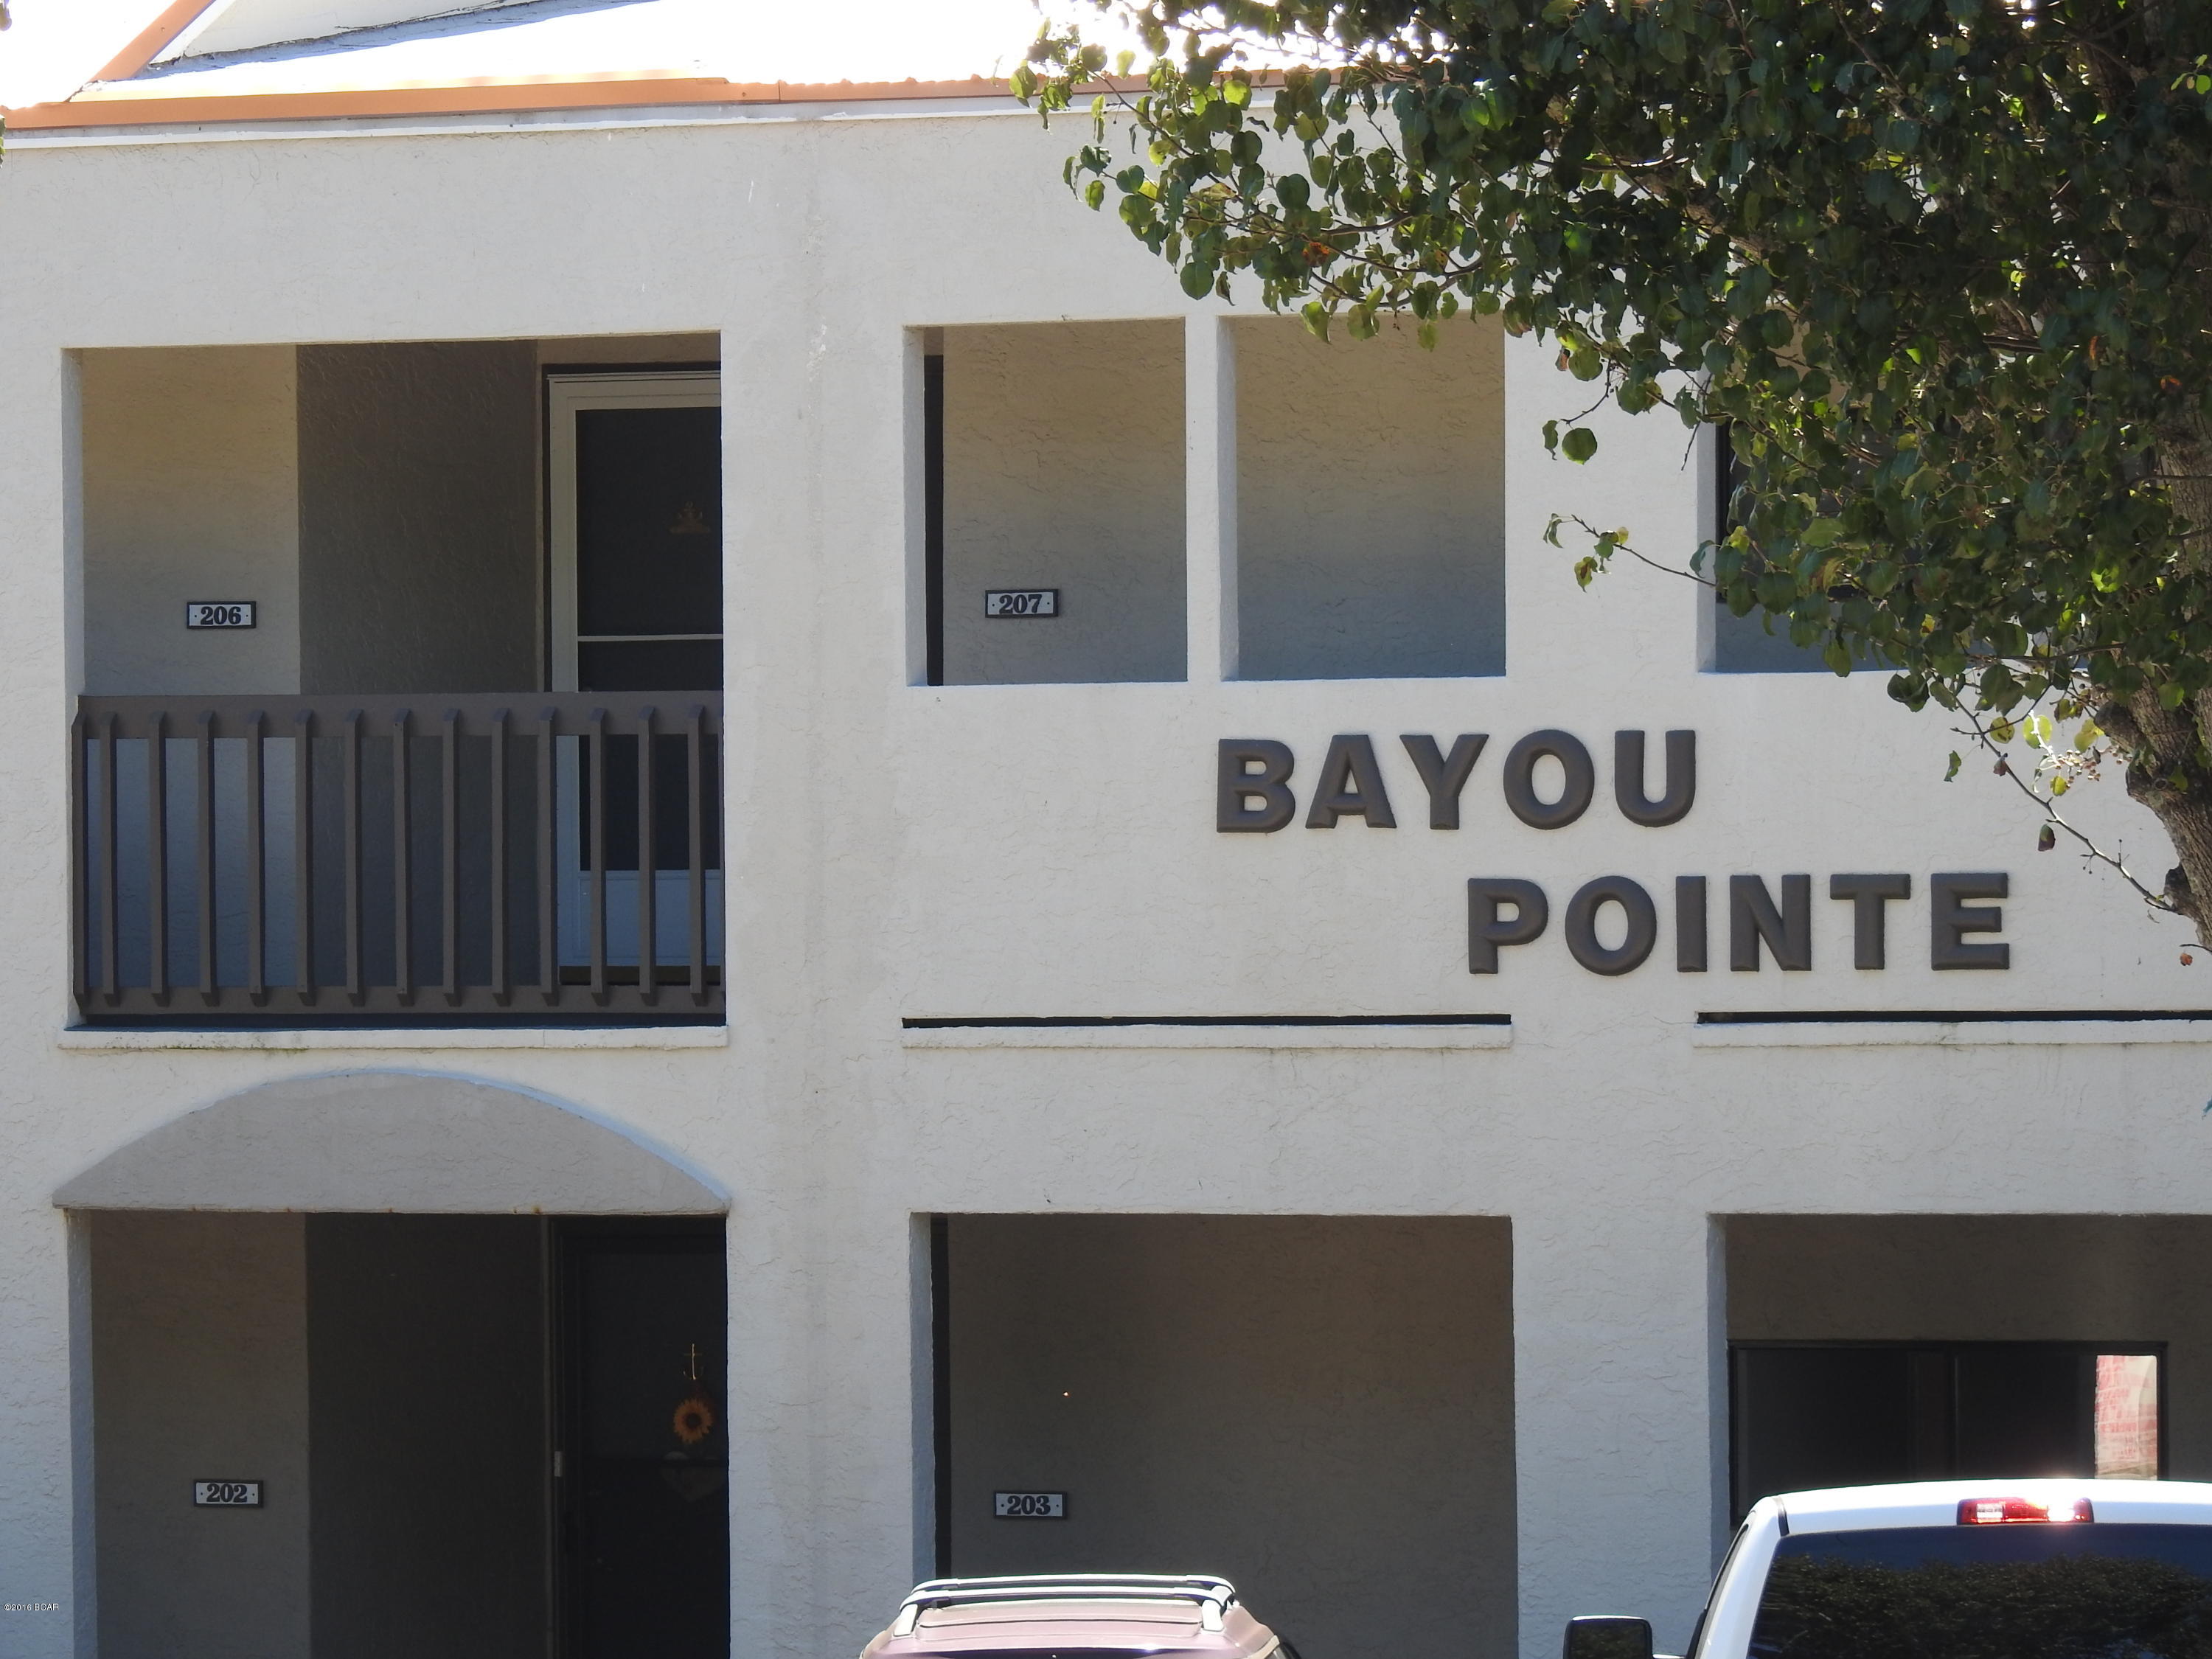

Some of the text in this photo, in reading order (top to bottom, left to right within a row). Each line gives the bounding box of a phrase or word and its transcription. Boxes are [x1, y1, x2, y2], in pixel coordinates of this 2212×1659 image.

[999, 594, 1043, 613] 207
[200, 606, 241, 625] 206
[1217, 729, 1696, 832] BAYOU
[1467, 872, 2010, 976] POINTE
[206, 1483, 248, 1503] 202
[1007, 1495, 1051, 1514] 203
